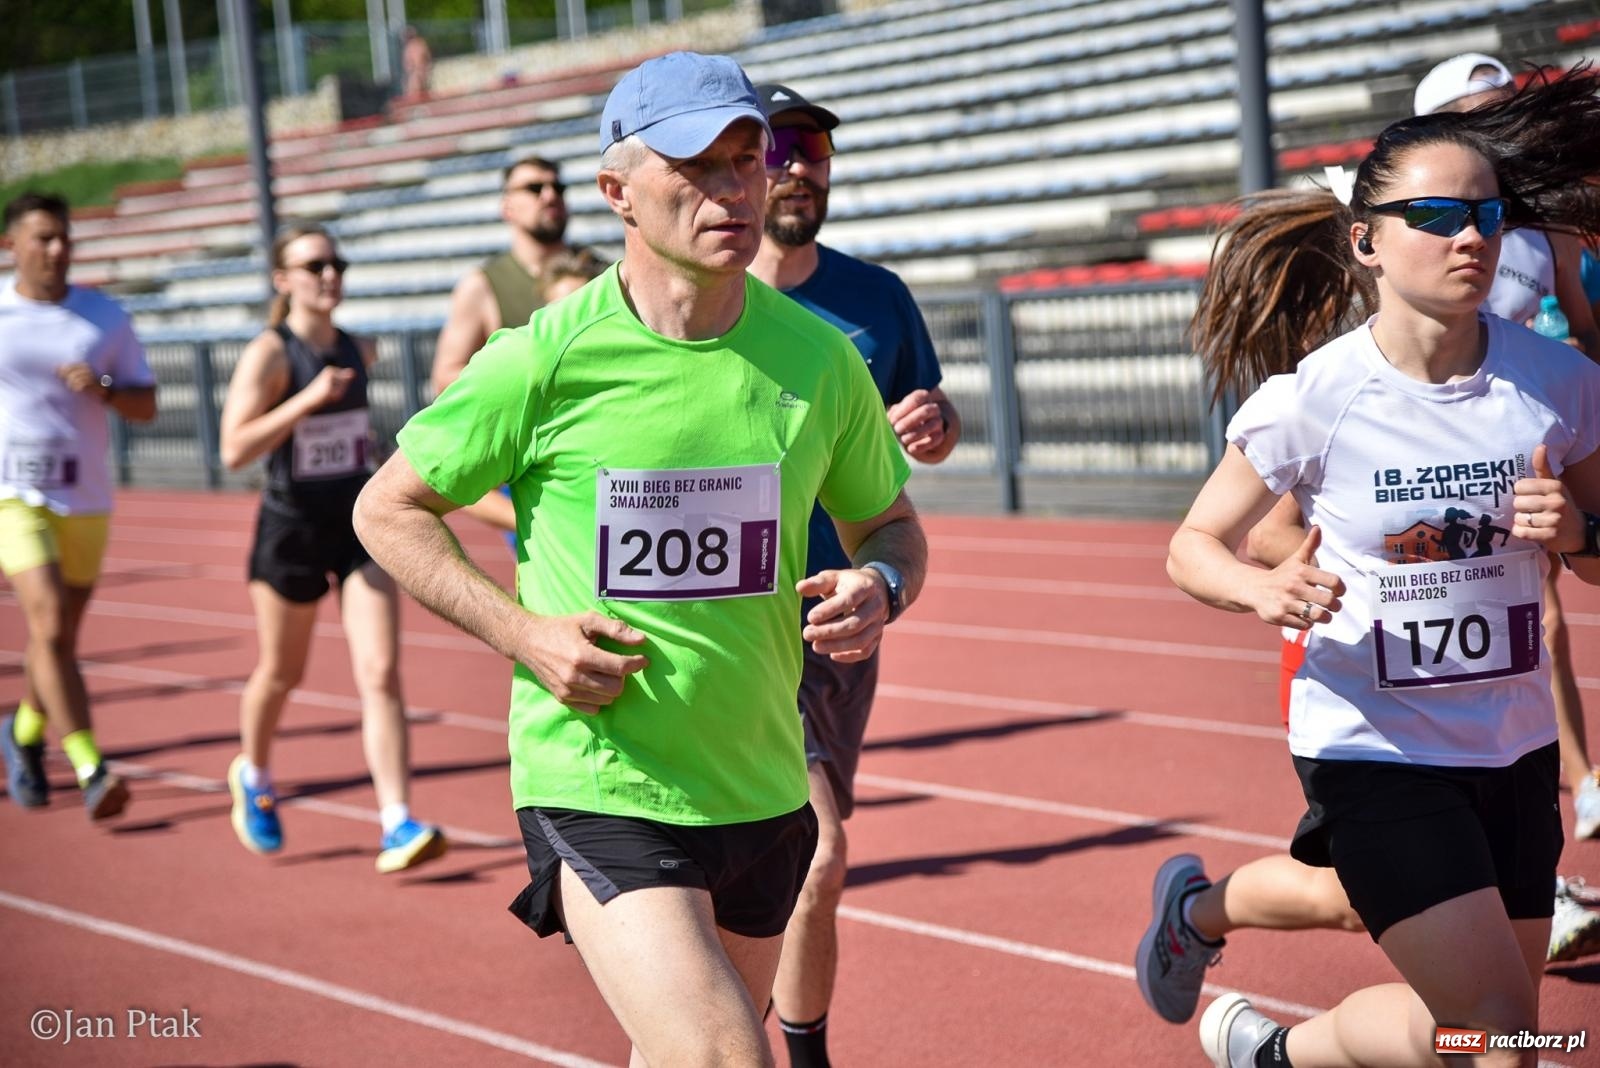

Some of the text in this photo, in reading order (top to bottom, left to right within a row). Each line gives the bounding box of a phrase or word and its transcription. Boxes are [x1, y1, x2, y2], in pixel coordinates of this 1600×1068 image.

[610, 476, 743, 494] XVIII BIEG BEZ GRANIC
[1374, 468, 1412, 487] 18.
[610, 495, 680, 509] 3MAJA2026
[1375, 487, 1424, 503] BIEG
[619, 527, 729, 577] 208
[1379, 564, 1505, 589] XVIII BIEG BEZ GRANIC
[1380, 586, 1448, 603] 3MAJA2026
[1403, 614, 1491, 666] 170
